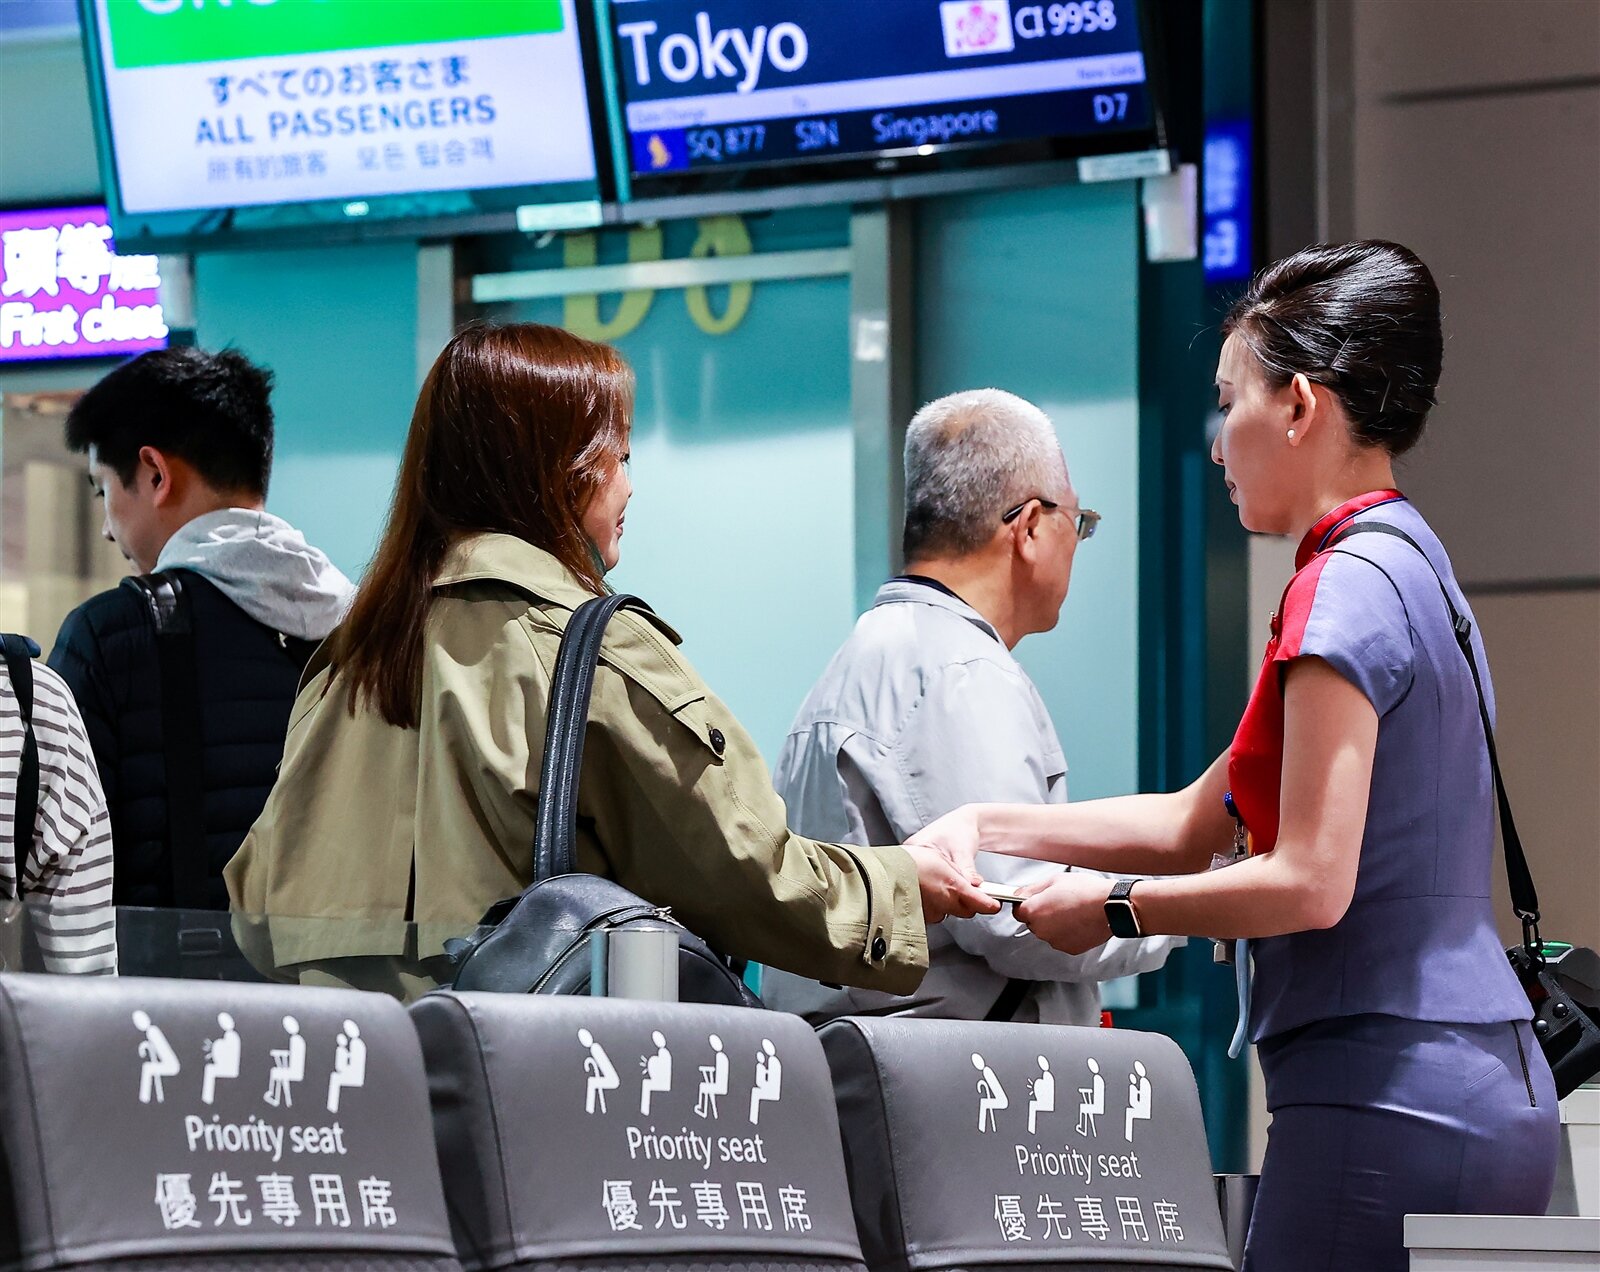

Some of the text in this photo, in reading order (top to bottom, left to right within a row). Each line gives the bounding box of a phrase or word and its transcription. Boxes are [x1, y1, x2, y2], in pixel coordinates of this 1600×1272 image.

[1047, 0, 1117, 36] 9958
[618, 11, 809, 94] Tokyo
[206, 55, 470, 107] すべてのお客さま
[196, 94, 497, 146] ALL PASSENGERS
[685, 92, 1129, 161] SQ 877 SIN Singapore D7
[1, 301, 80, 348] First
[185, 1115, 347, 1162] Priority seat
[626, 1126, 767, 1170] Priority seat
[1015, 1144, 1142, 1184] Priority seat
[155, 1171, 398, 1229] 優先專用席
[602, 1179, 812, 1233] 優先專用席
[993, 1193, 1185, 1243] 優先專用席
